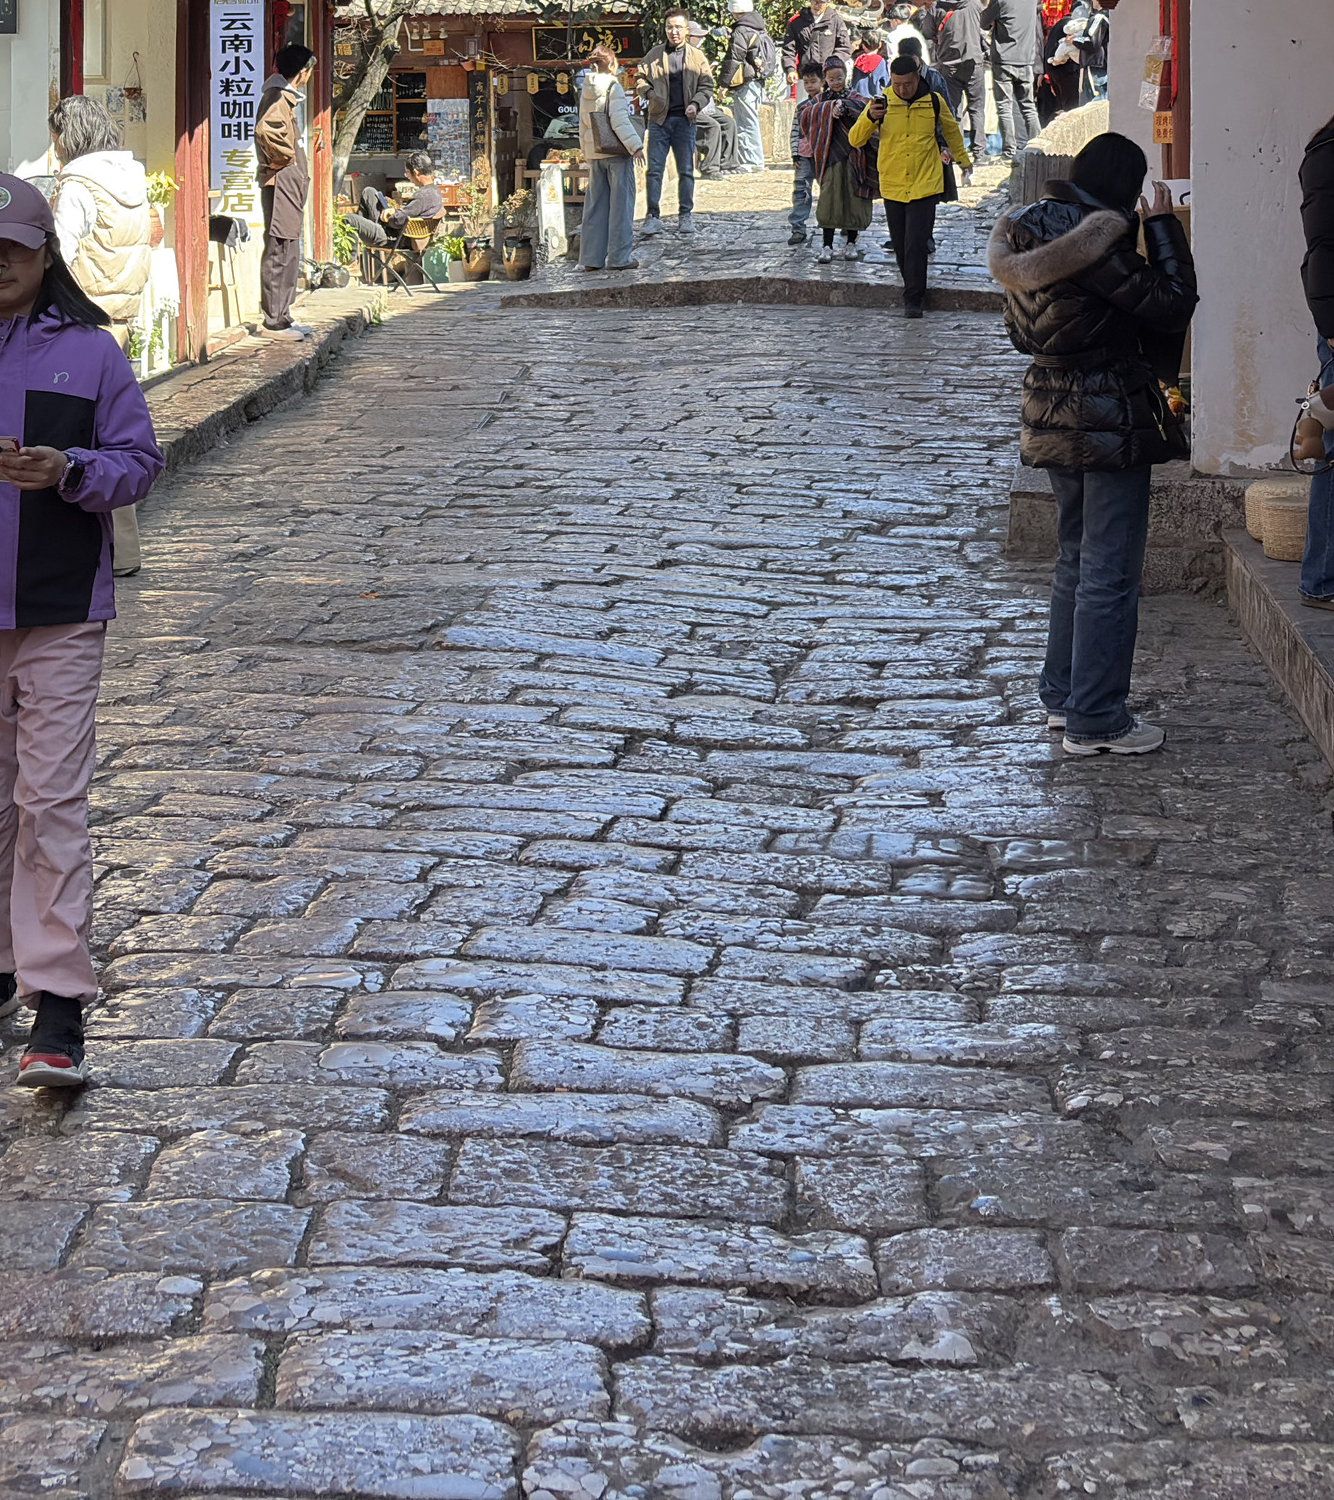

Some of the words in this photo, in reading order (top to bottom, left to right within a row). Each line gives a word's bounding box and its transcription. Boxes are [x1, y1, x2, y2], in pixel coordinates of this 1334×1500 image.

[219, 12, 255, 141] 云南小粒咖啡
[220, 148, 255, 213] 专营店
